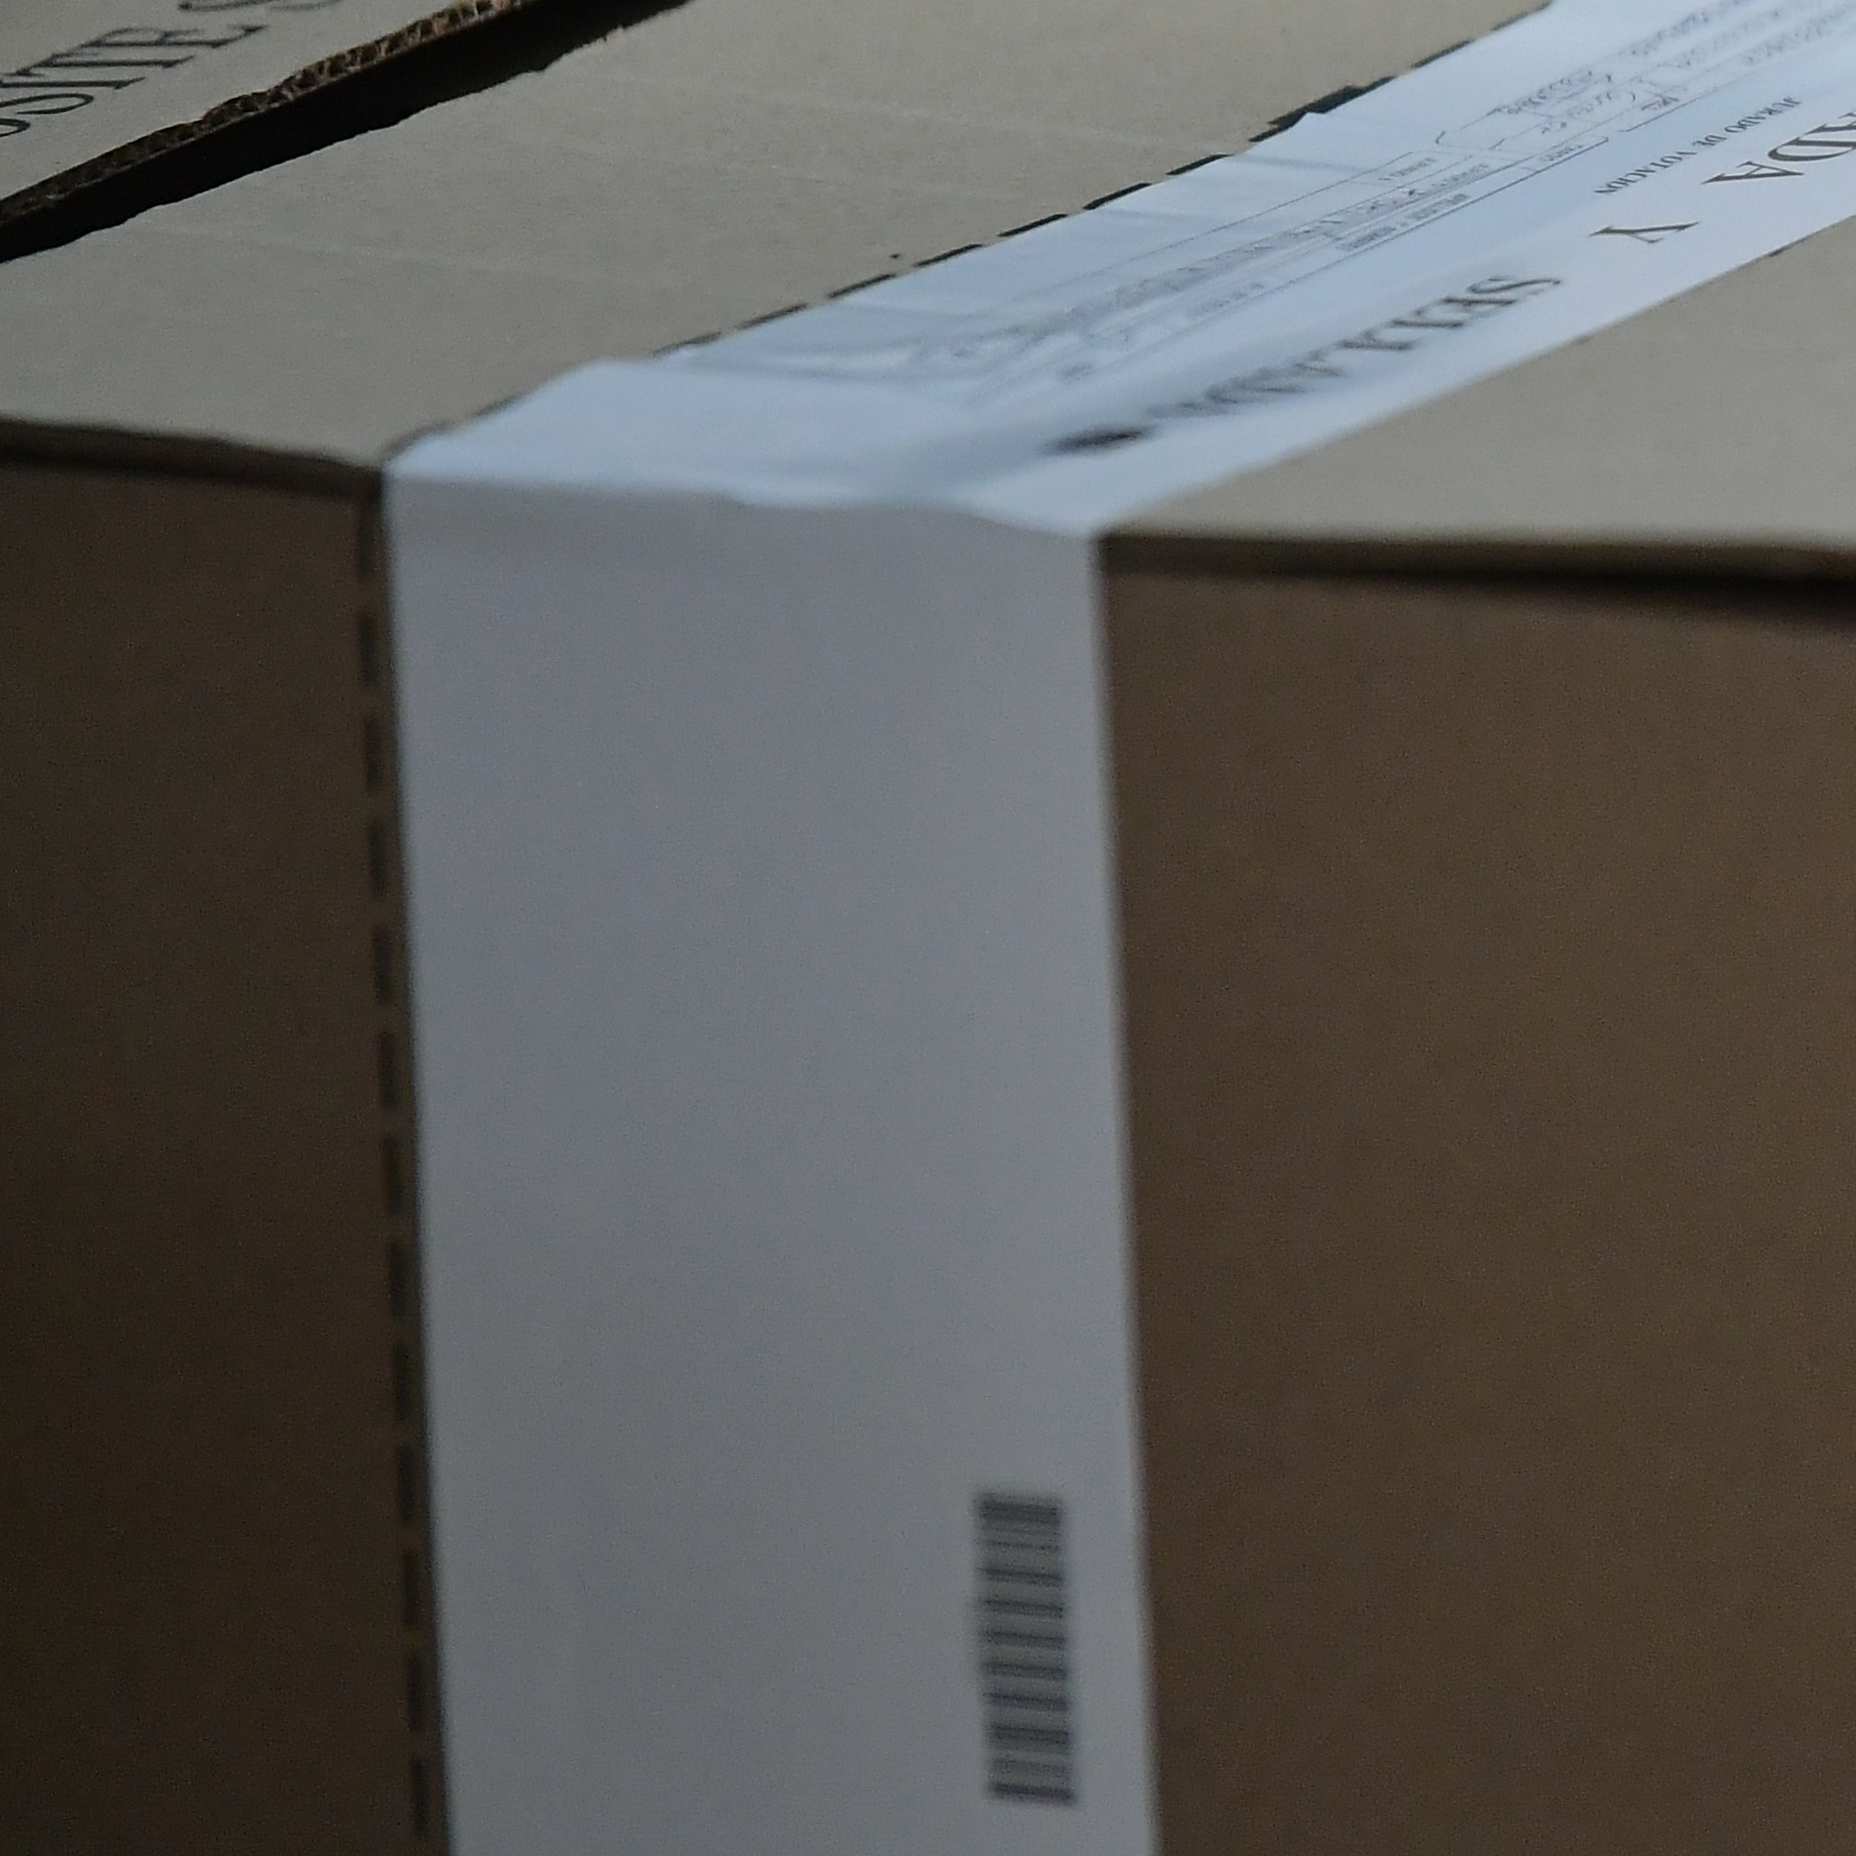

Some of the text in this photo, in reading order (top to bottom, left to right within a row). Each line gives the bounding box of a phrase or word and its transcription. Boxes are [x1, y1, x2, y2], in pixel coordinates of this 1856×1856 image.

[1723, 96, 1802, 135] JURADO
[1691, 132, 1728, 150] DE
[1587, 217, 1700, 246] Y
